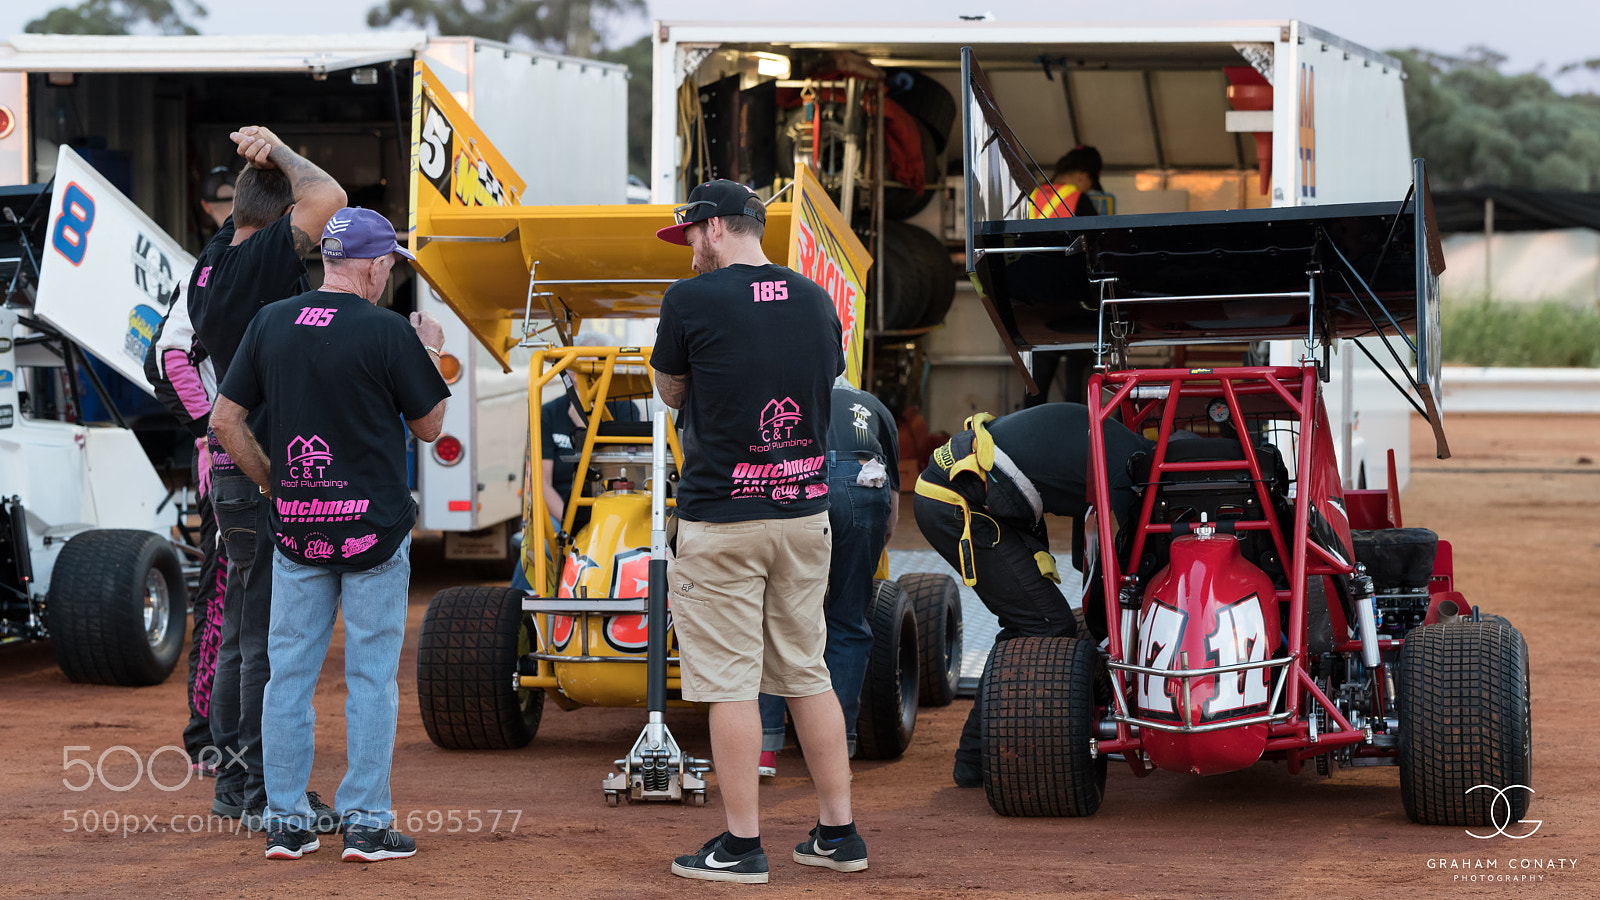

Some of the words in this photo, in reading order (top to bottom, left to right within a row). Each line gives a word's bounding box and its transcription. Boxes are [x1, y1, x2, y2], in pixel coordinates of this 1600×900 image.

[419, 106, 451, 179] 5
[52, 181, 96, 267] 8
[750, 280, 789, 302] 185
[294, 307, 338, 327] 185
[762, 430, 770, 442] C
[773, 427, 781, 440] &
[785, 426, 793, 438] T
[289, 466, 299, 479] C
[302, 466, 313, 479] &
[315, 466, 326, 479] T
[731, 455, 825, 479] Dutchman
[281, 480, 299, 488] Roof
[304, 539, 335, 559] Elite
[1203, 594, 1269, 720] 17
